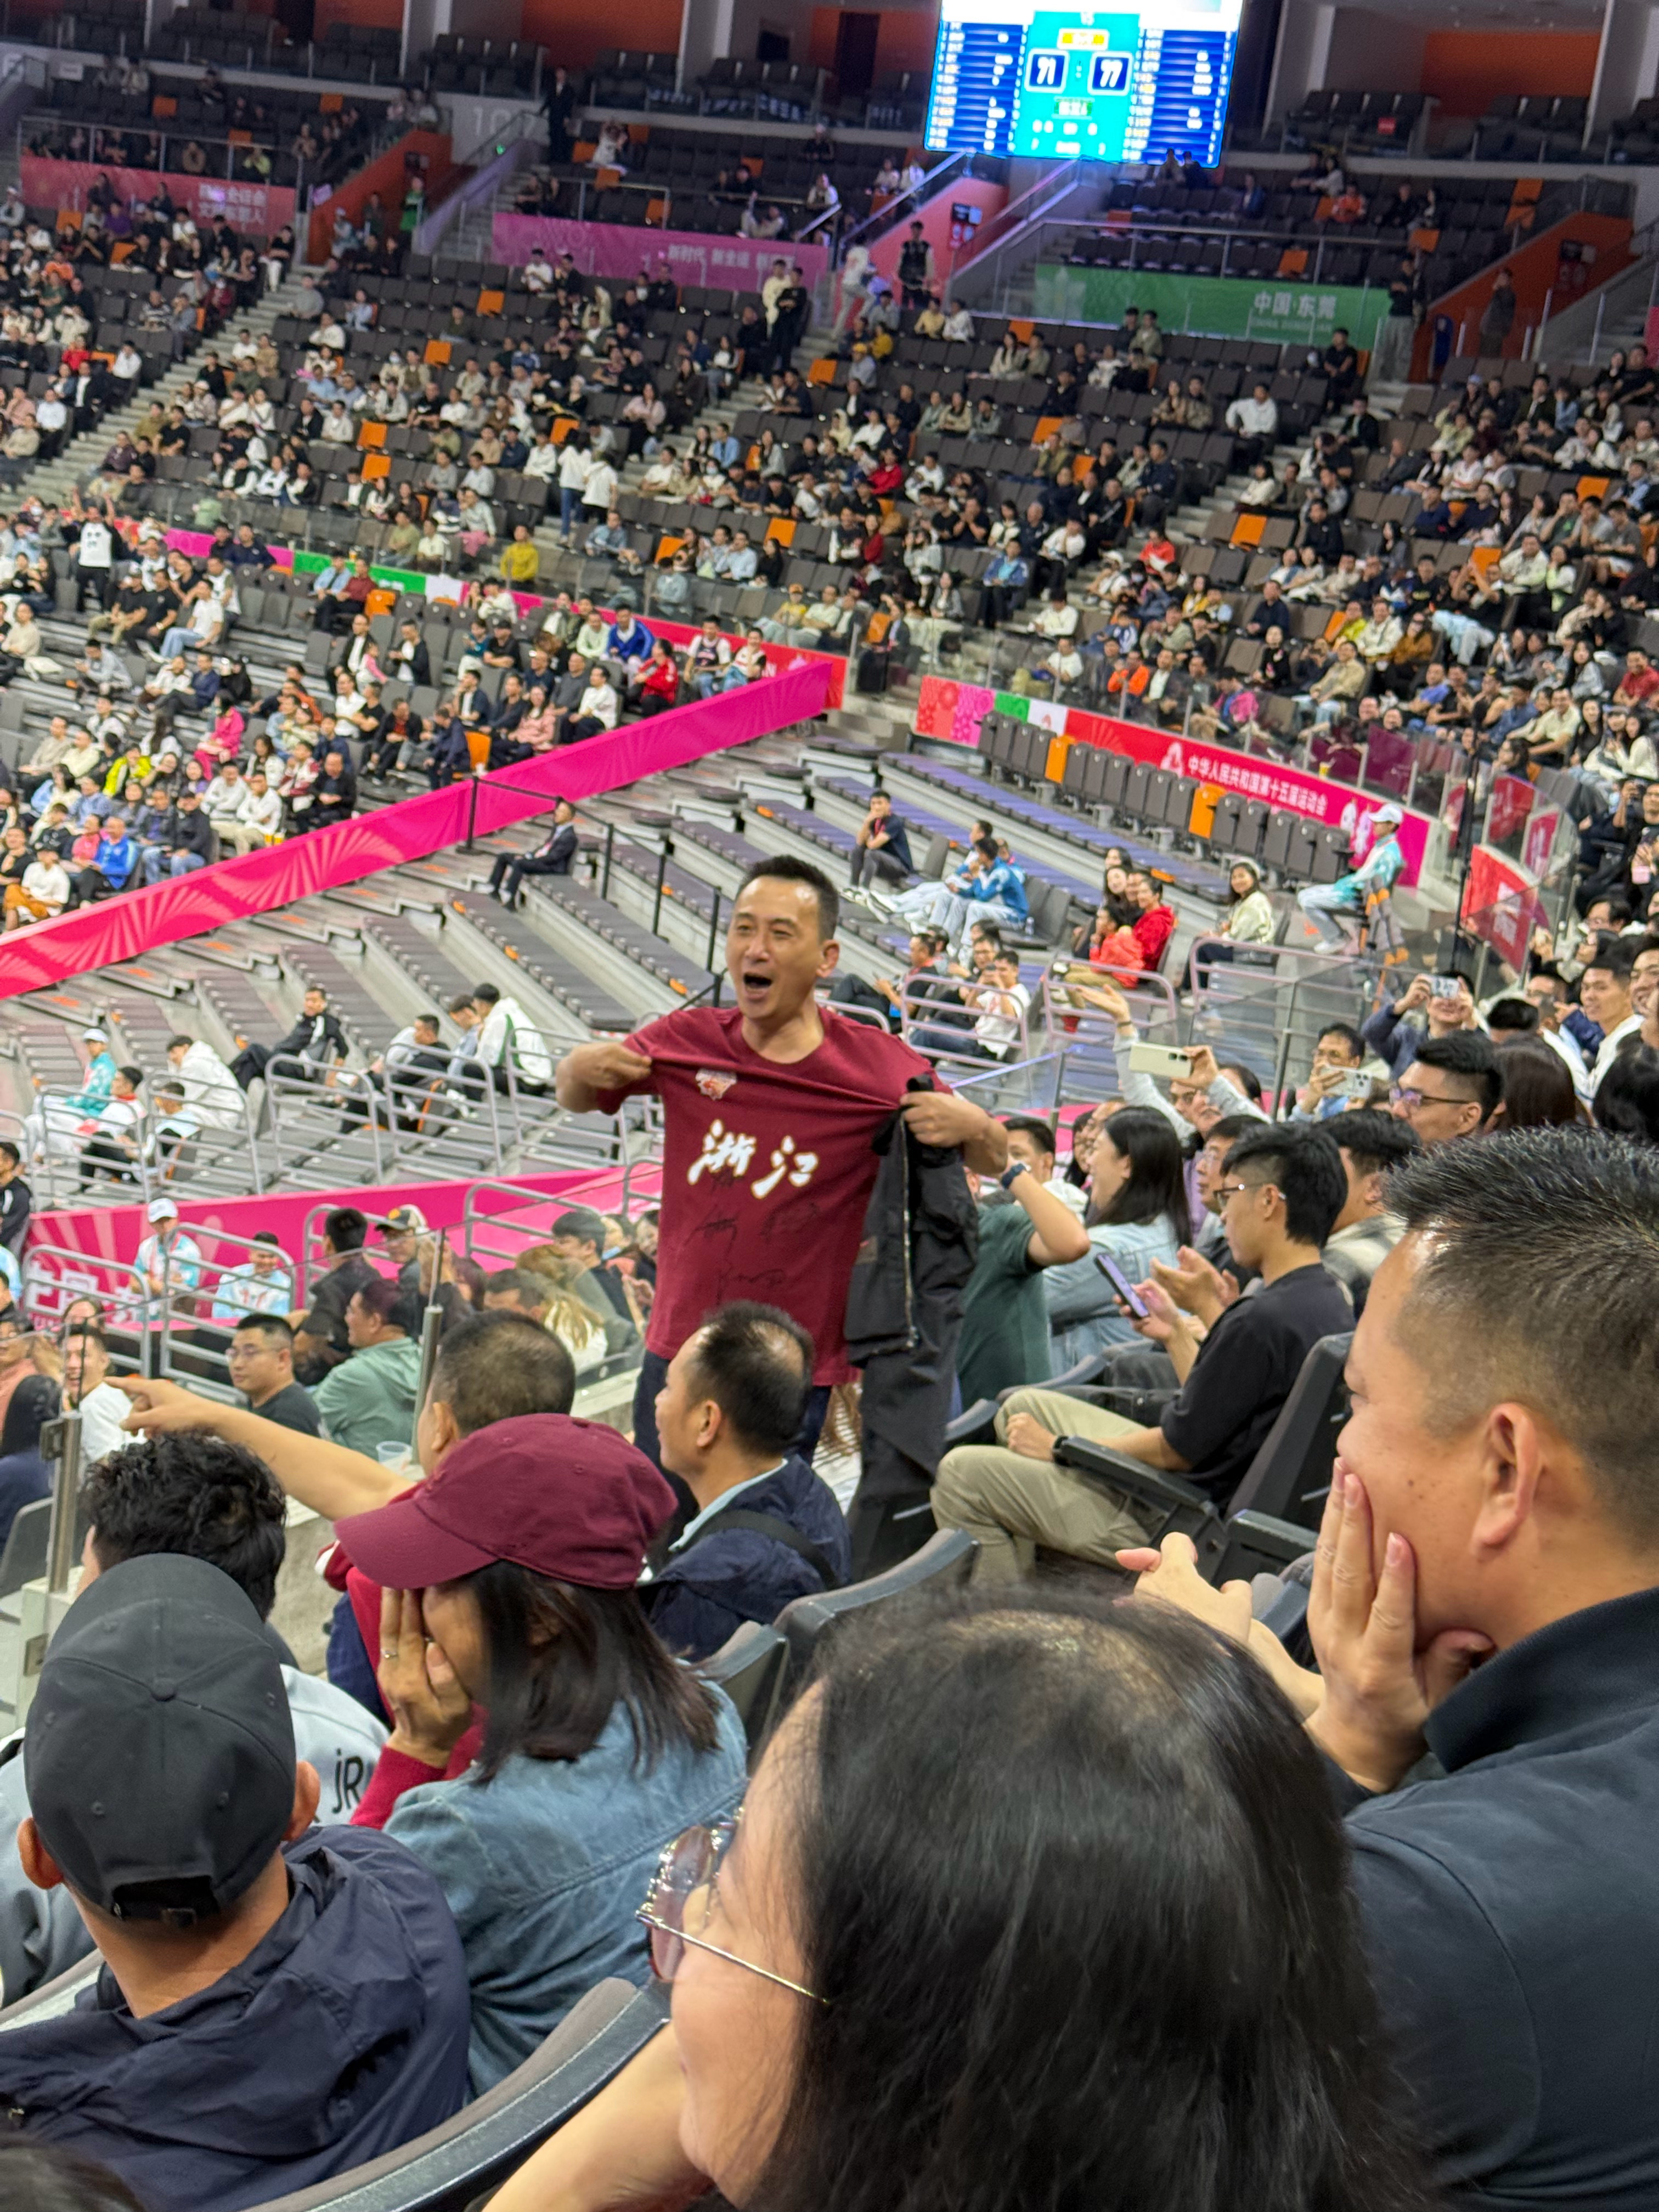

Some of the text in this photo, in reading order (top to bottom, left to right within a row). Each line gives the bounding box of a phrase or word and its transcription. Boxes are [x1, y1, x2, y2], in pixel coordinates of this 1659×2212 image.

[1036, 56, 1124, 88] 71 77
[1188, 753, 1328, 817] 中华人民共和国第十五届运动会
[687, 1118, 820, 1200] 浙江
